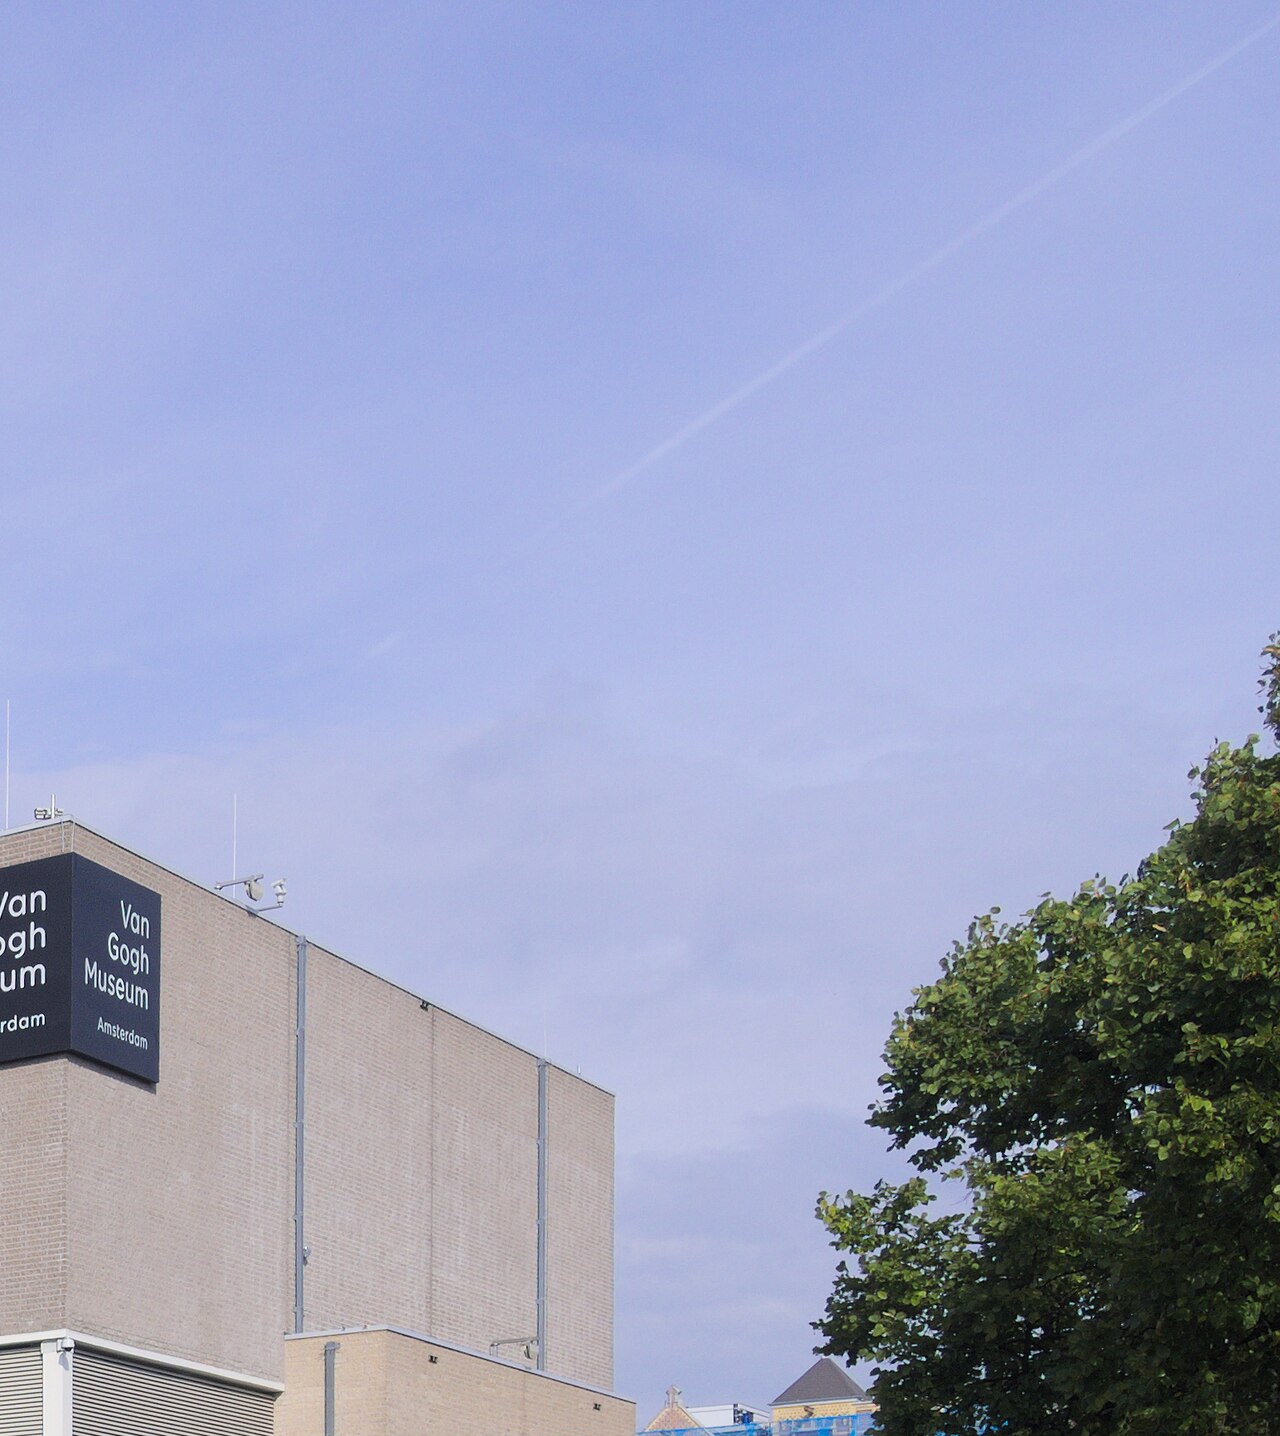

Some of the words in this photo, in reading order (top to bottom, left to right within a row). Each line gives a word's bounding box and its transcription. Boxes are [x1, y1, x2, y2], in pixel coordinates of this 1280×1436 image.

[120, 900, 150, 939] Van
[108, 931, 149, 975] Gogh
[84, 957, 149, 1010] Museum
[97, 1017, 148, 1050] Amsterdam
